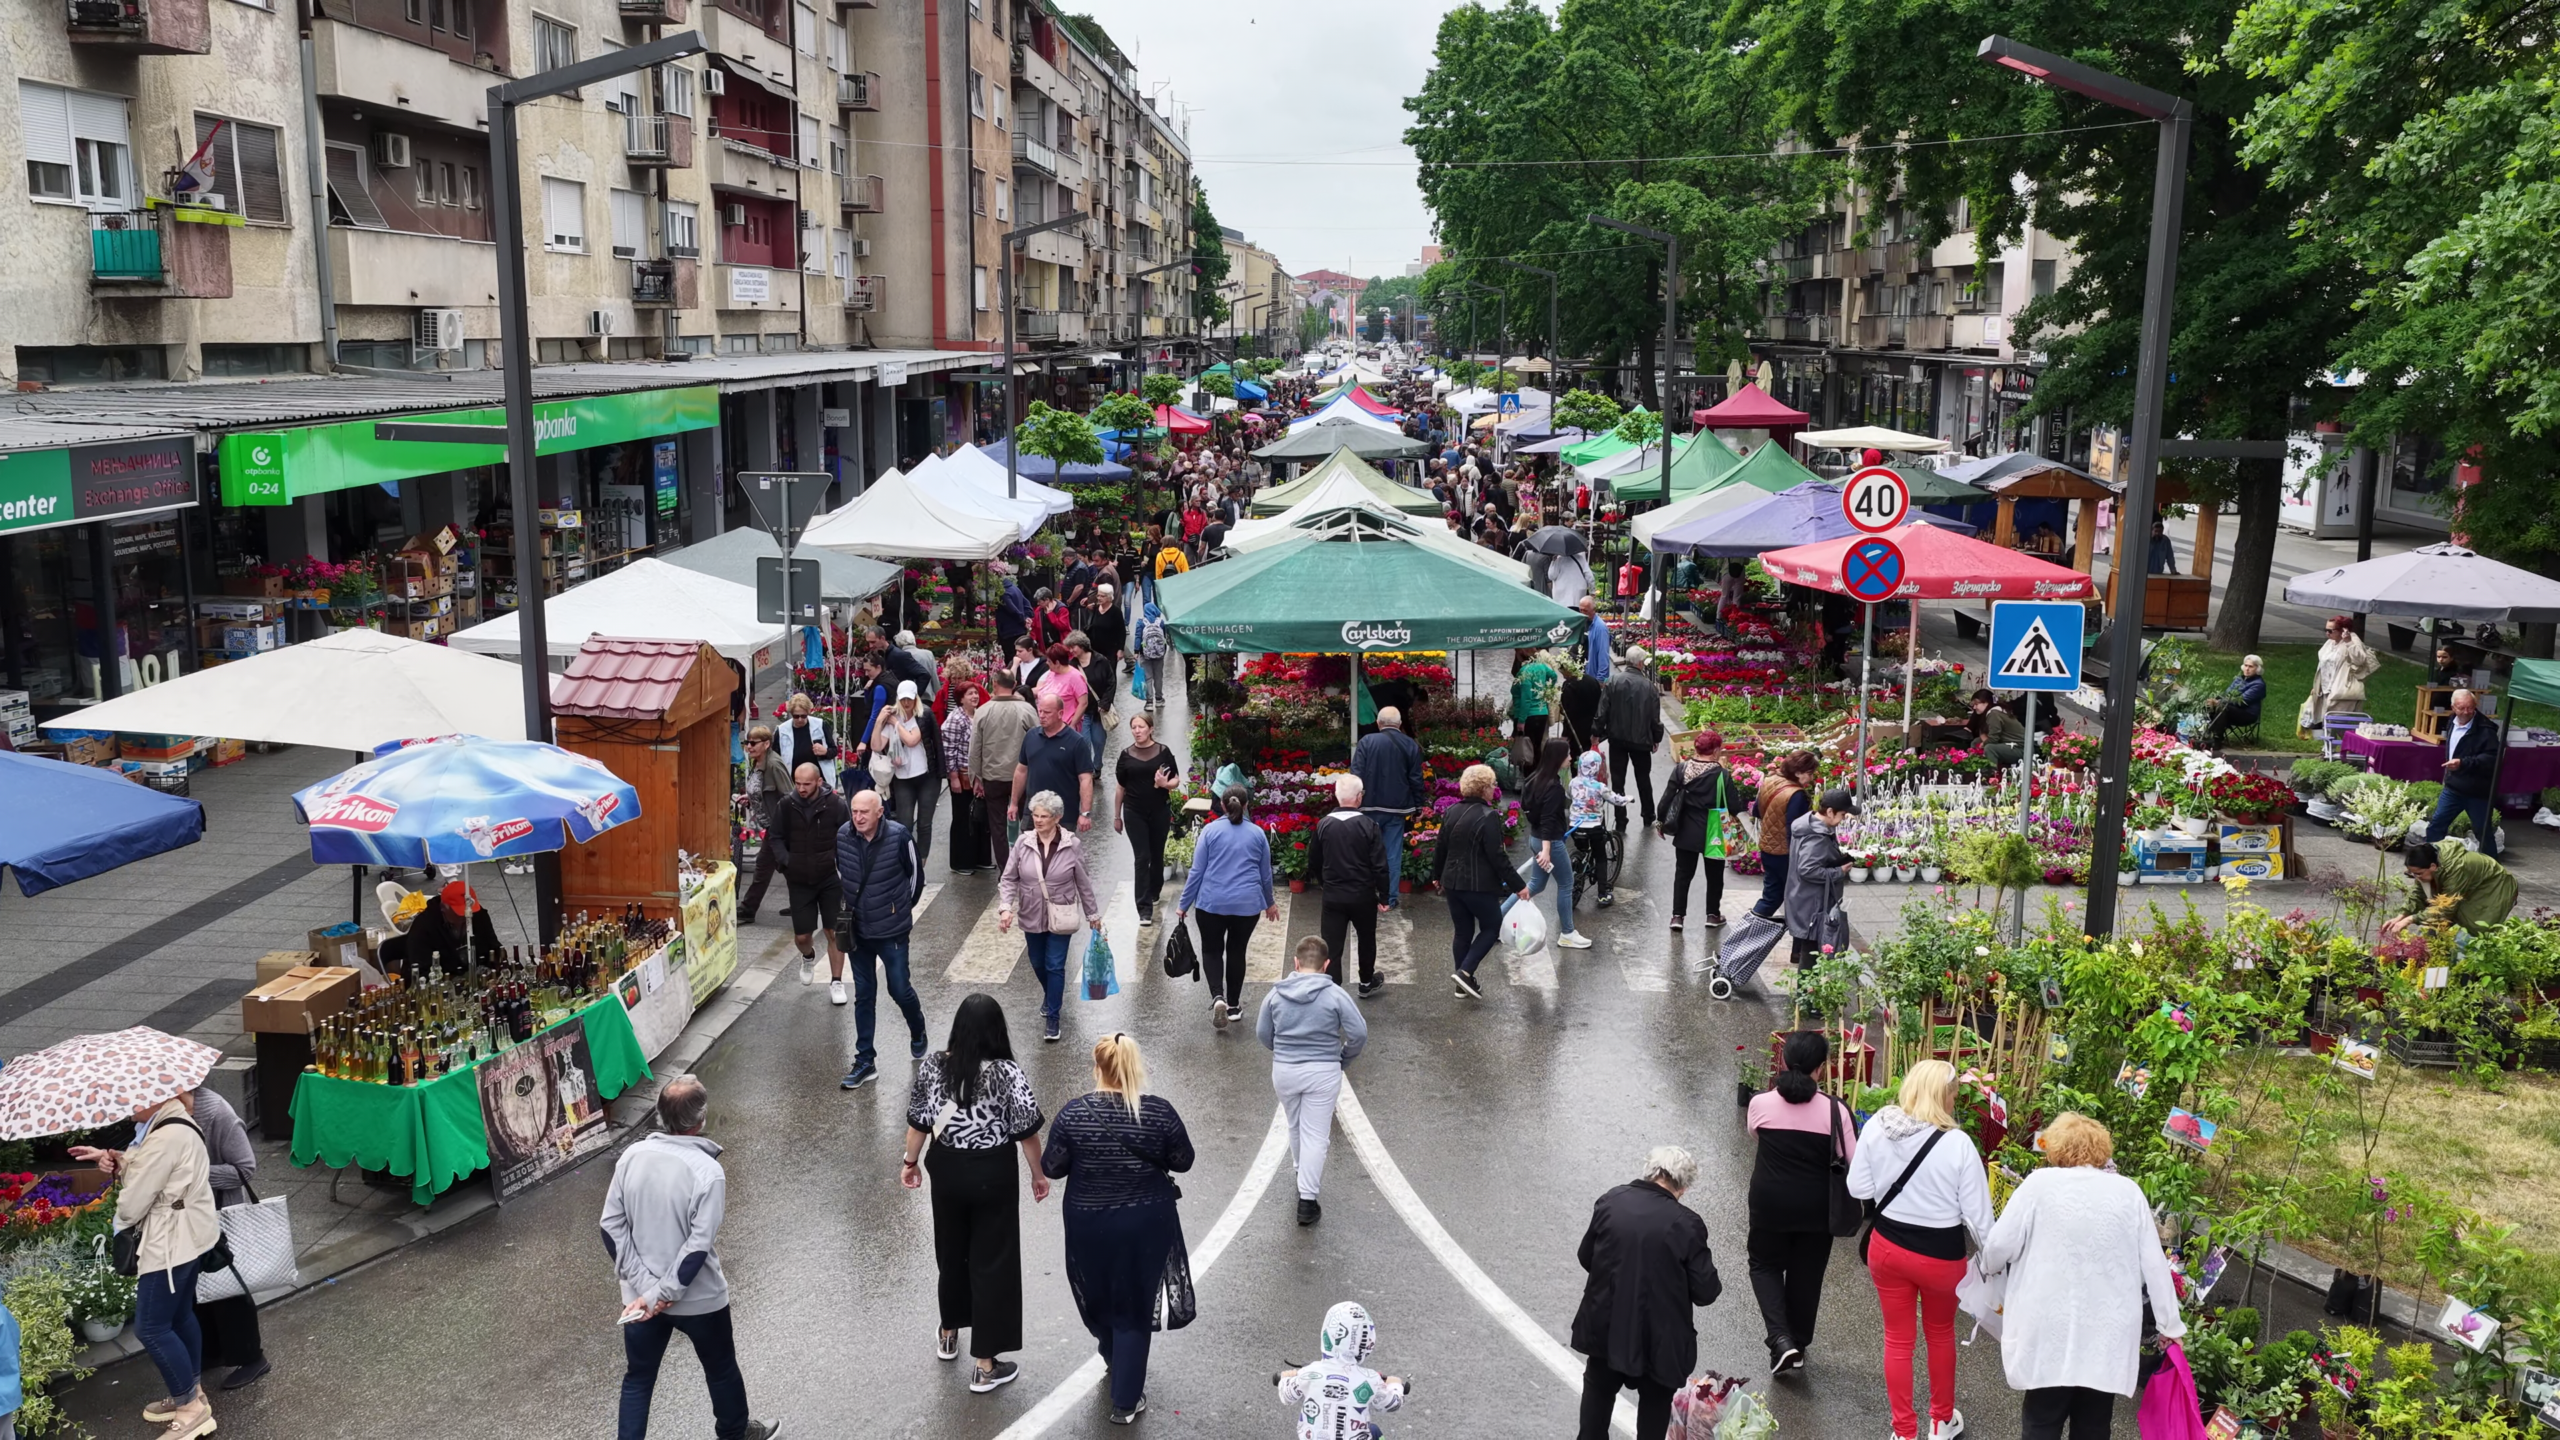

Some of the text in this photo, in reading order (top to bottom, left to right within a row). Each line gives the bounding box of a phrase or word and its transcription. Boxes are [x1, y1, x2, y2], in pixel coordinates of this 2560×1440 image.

[826, 413, 848, 422] Bonatti
[90, 450, 182, 476] МЕЊАЧНИЦА
[244, 467, 280, 477] otpbanka
[85, 478, 191, 507] Exchange Office
[248, 482, 279, 495] 0-24
[0, 494, 57, 521] enter
[1855, 484, 1894, 517] 40
[152, 539, 177, 549] POSTCARDS
[1951, 580, 2002, 596] Зајечарско
[2033, 579, 2083, 596] Зајечарско
[1179, 624, 1254, 635] COPENHAGEN
[1341, 620, 1411, 649] Carlsberg
[1200, 638, 1235, 649] 1847
[1446, 636, 1460, 644] THE
[1488, 635, 1515, 643] DANISH
[314, 800, 394, 824] Frikom
[490, 820, 532, 843] Frikom
[2238, 864, 2265, 875] derby
